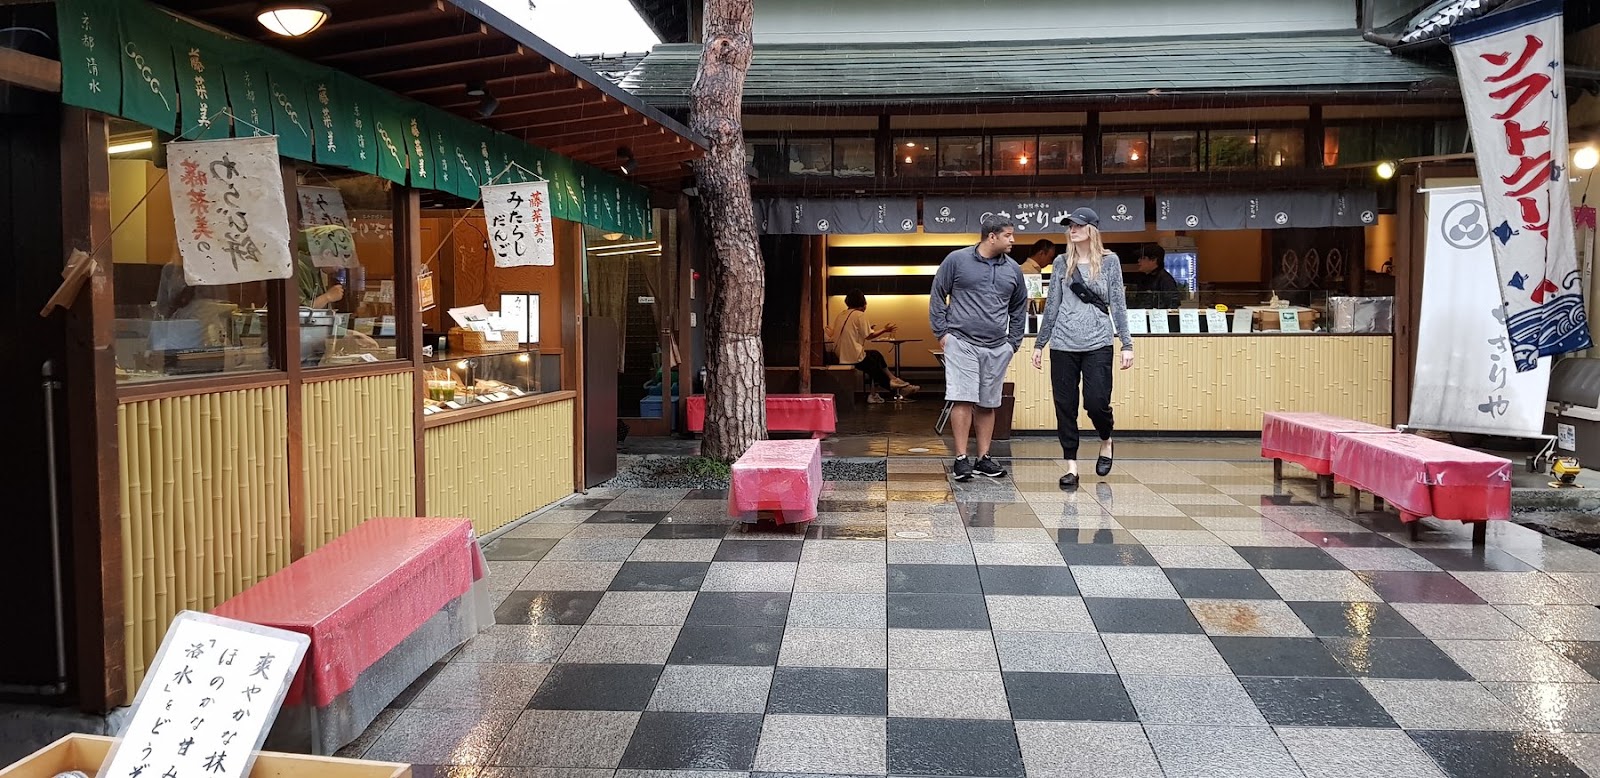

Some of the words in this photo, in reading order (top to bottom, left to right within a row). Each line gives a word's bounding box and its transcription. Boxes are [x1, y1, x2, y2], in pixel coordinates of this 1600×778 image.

[81, 12, 101, 94] 京都清水
[188, 47, 211, 130] 藤菜美
[317, 83, 337, 153] 藤菜美
[493, 214, 508, 258] だんご
[506, 191, 527, 257] みたらし
[528, 190, 545, 244] 藤菜美の
